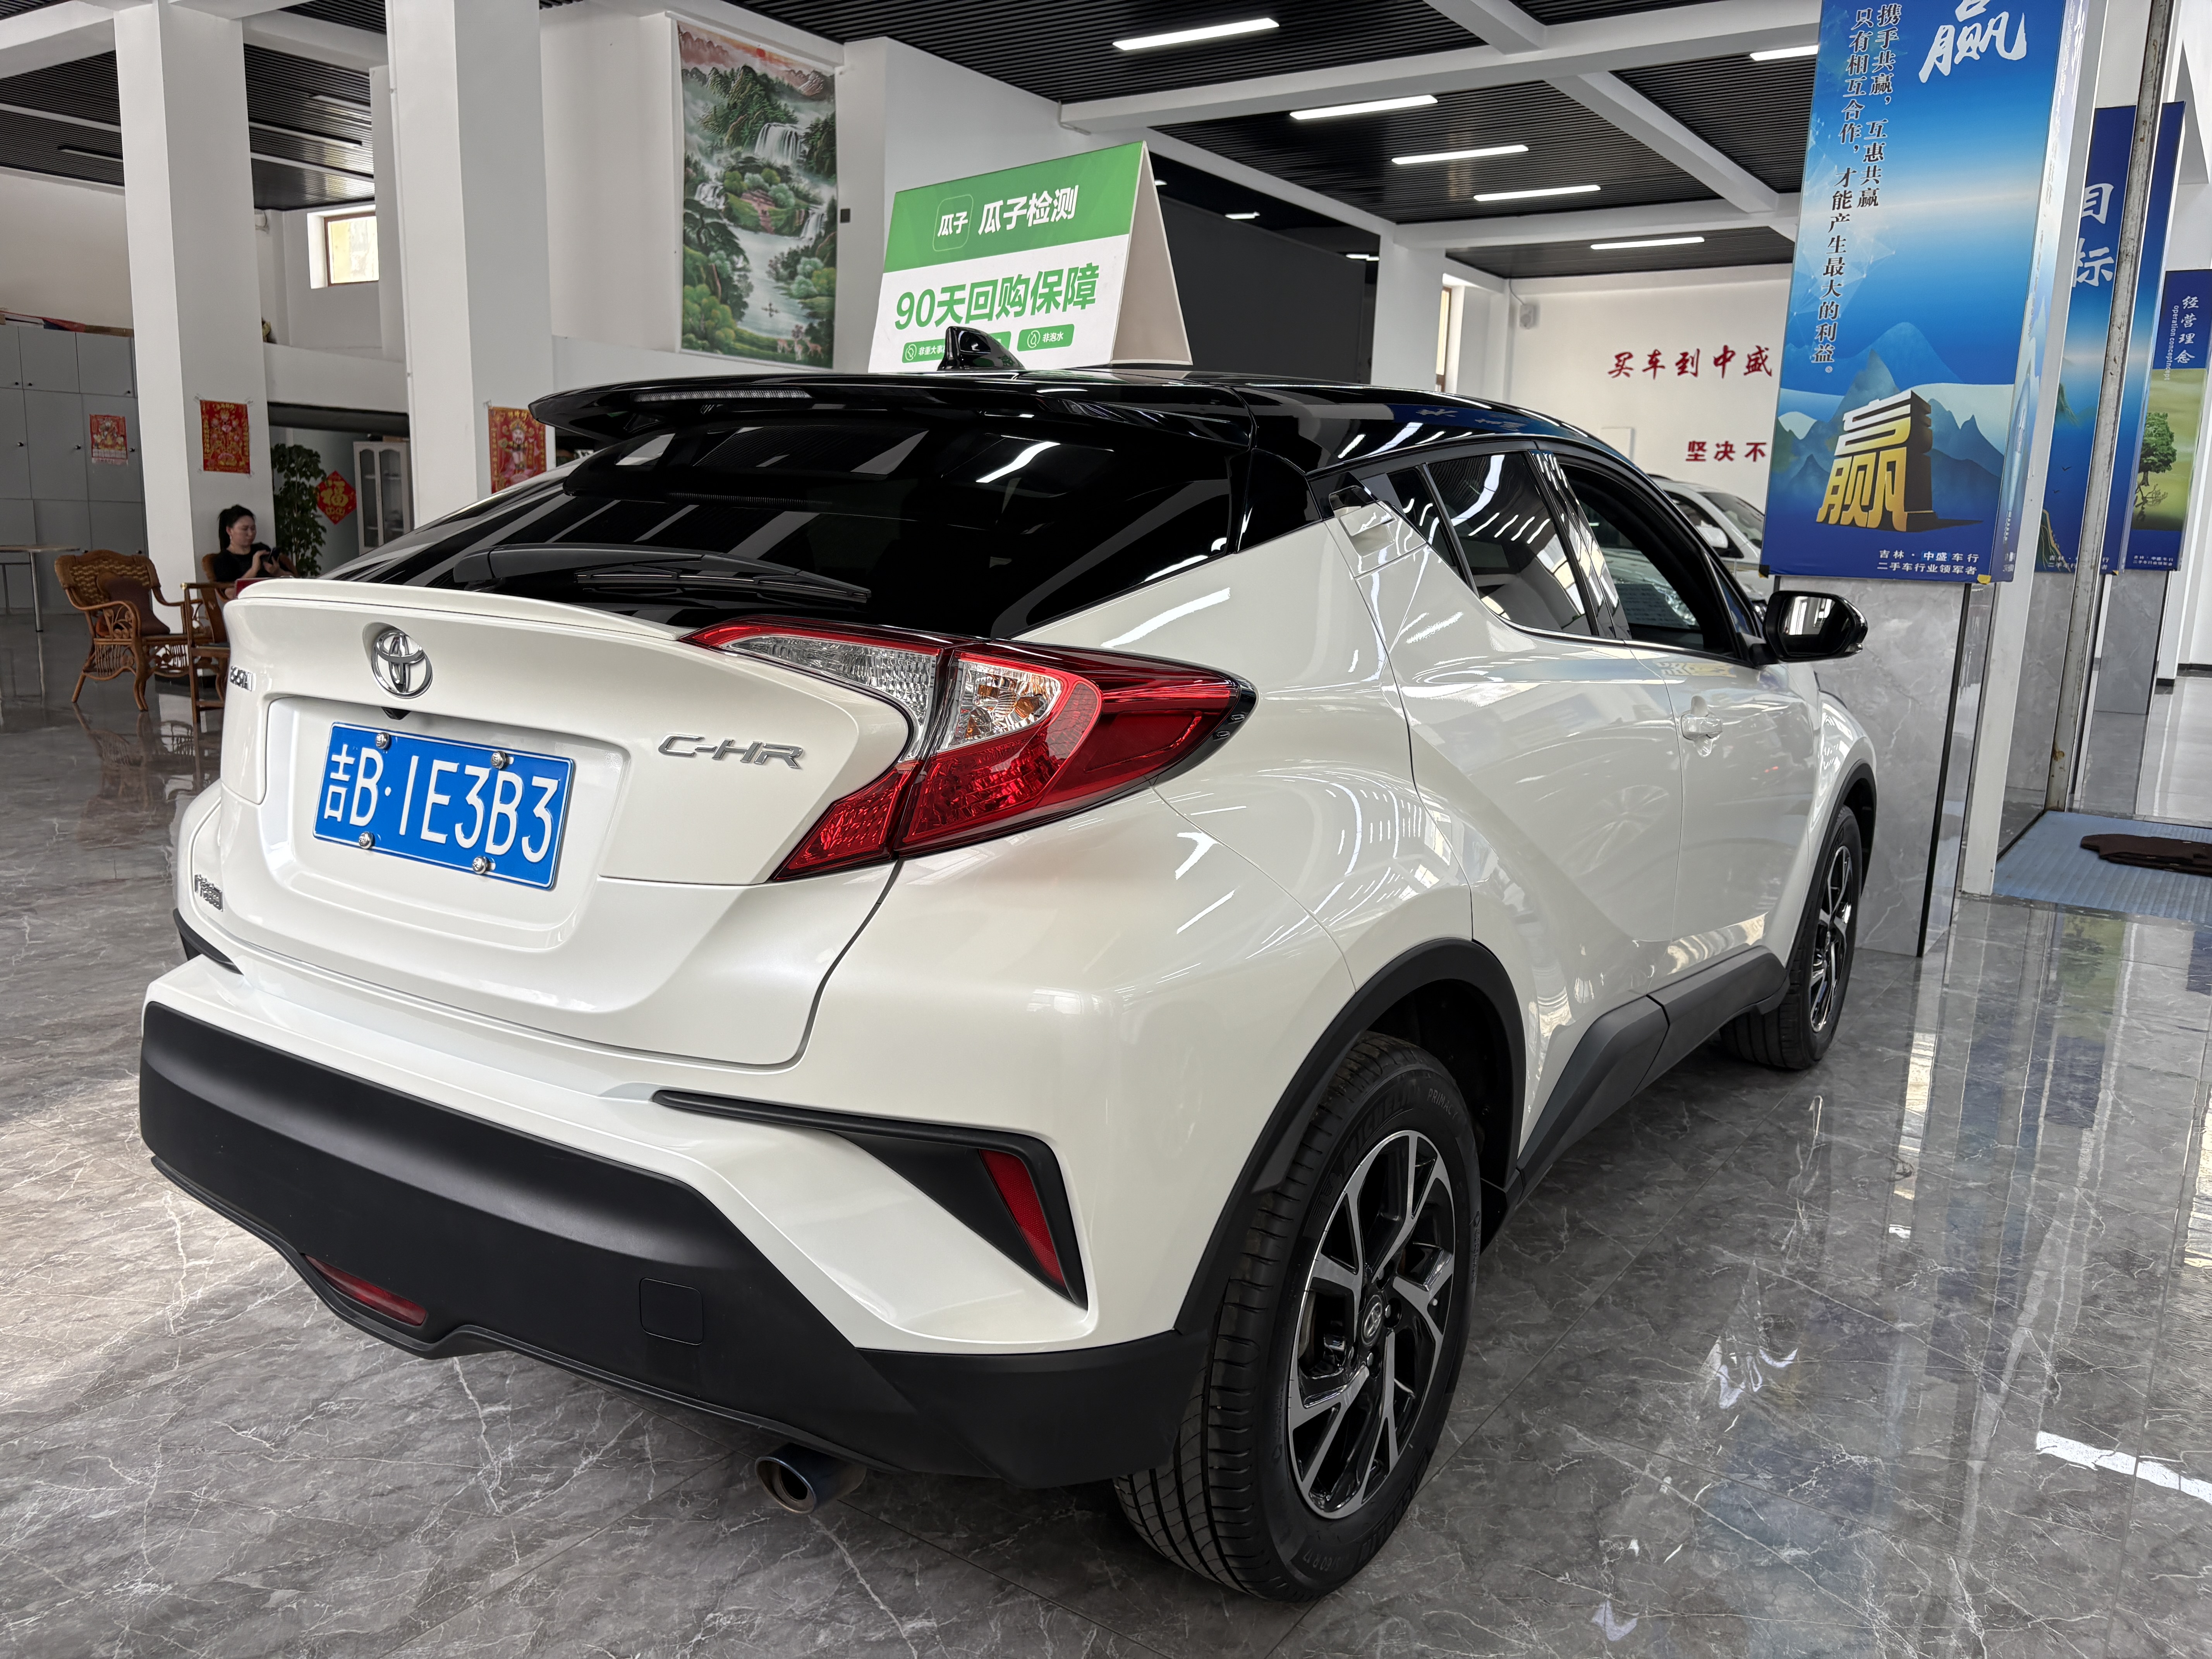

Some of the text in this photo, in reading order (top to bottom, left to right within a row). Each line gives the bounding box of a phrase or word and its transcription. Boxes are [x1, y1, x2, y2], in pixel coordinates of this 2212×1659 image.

[1919, 0, 2027, 83] 赢
[1856, 3, 1902, 208] 携手共赢，互惠共赢
[938, 185, 1079, 237] 瓜子 瓜子检测
[1811, 8, 1874, 373] 只有相互合作，才能产生最大的利益。
[2072, 183, 2114, 287] 目标
[894, 262, 1100, 330] 90天回购保障
[1042, 331, 1064, 342] 非泡水
[2170, 305, 2179, 336] operation
[2174, 296, 2199, 363] 经营理念
[1607, 345, 1772, 380] 买车到中盛
[1686, 441, 1767, 462] 坚决不
[1816, 390, 1932, 532] 赢
[320, 481, 349, 508] 福
[1877, 562, 1977, 575] 二手车行业领军者
[658, 734, 804, 769] C-HR
[1427, 1088, 1459, 1120] PRIMACY
